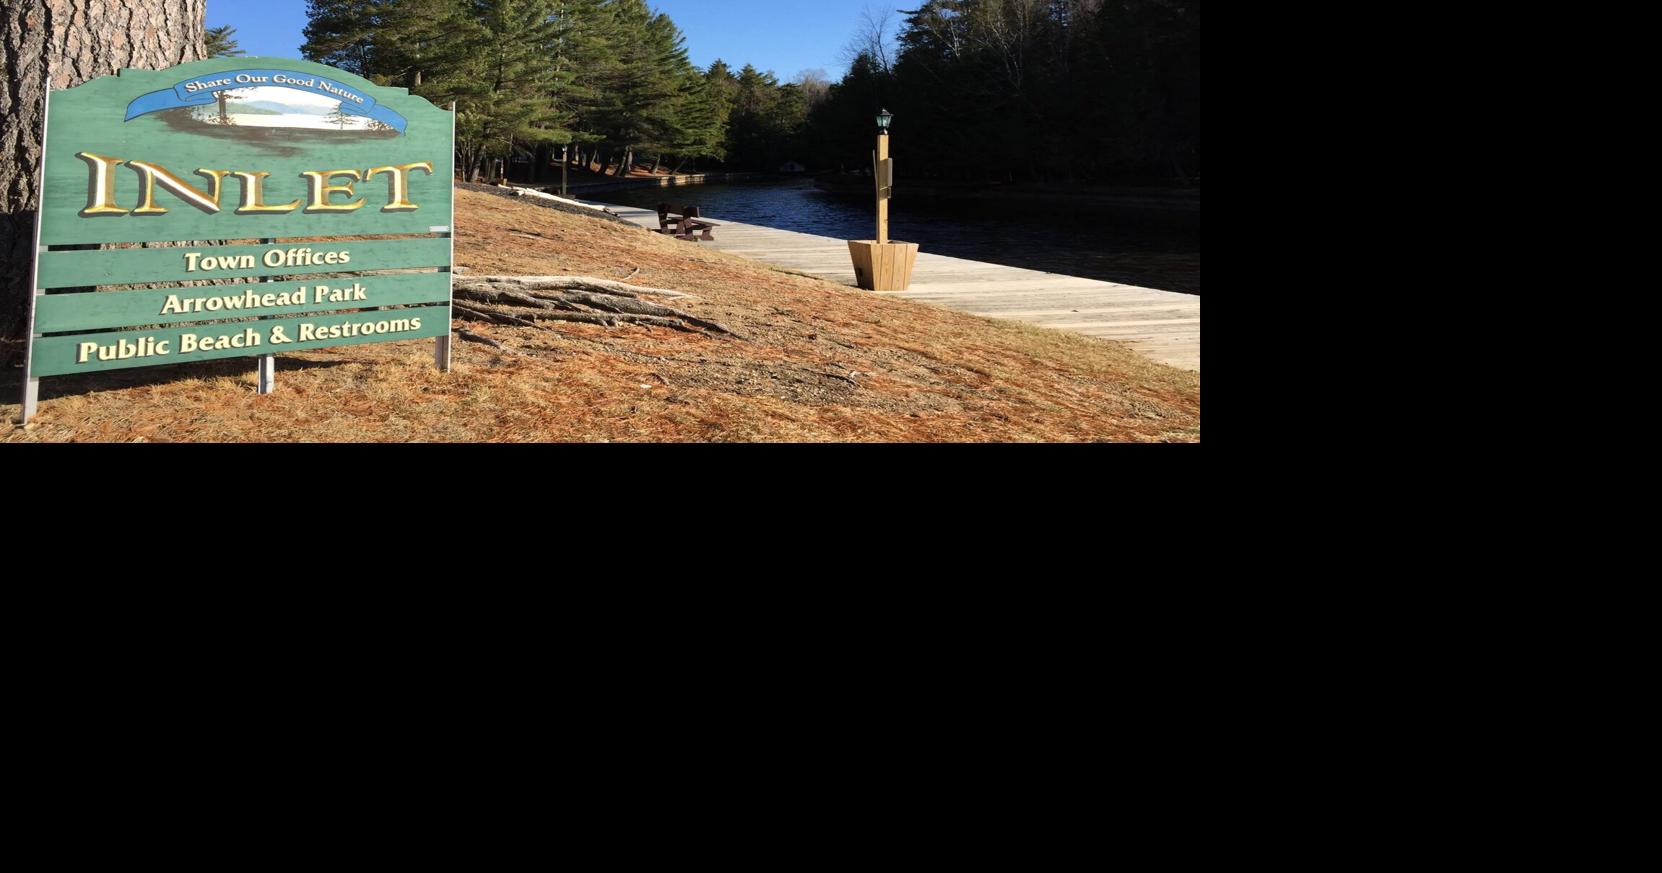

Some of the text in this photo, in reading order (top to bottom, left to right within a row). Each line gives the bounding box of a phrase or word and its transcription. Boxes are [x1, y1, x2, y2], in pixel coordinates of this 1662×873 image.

[185, 73, 365, 104] Share Our Good Nature
[76, 151, 433, 217] INLET
[184, 248, 351, 272] Town Offices
[160, 283, 367, 315] Arrowhead Park
[77, 315, 422, 363] Public Beach & Restrooms
